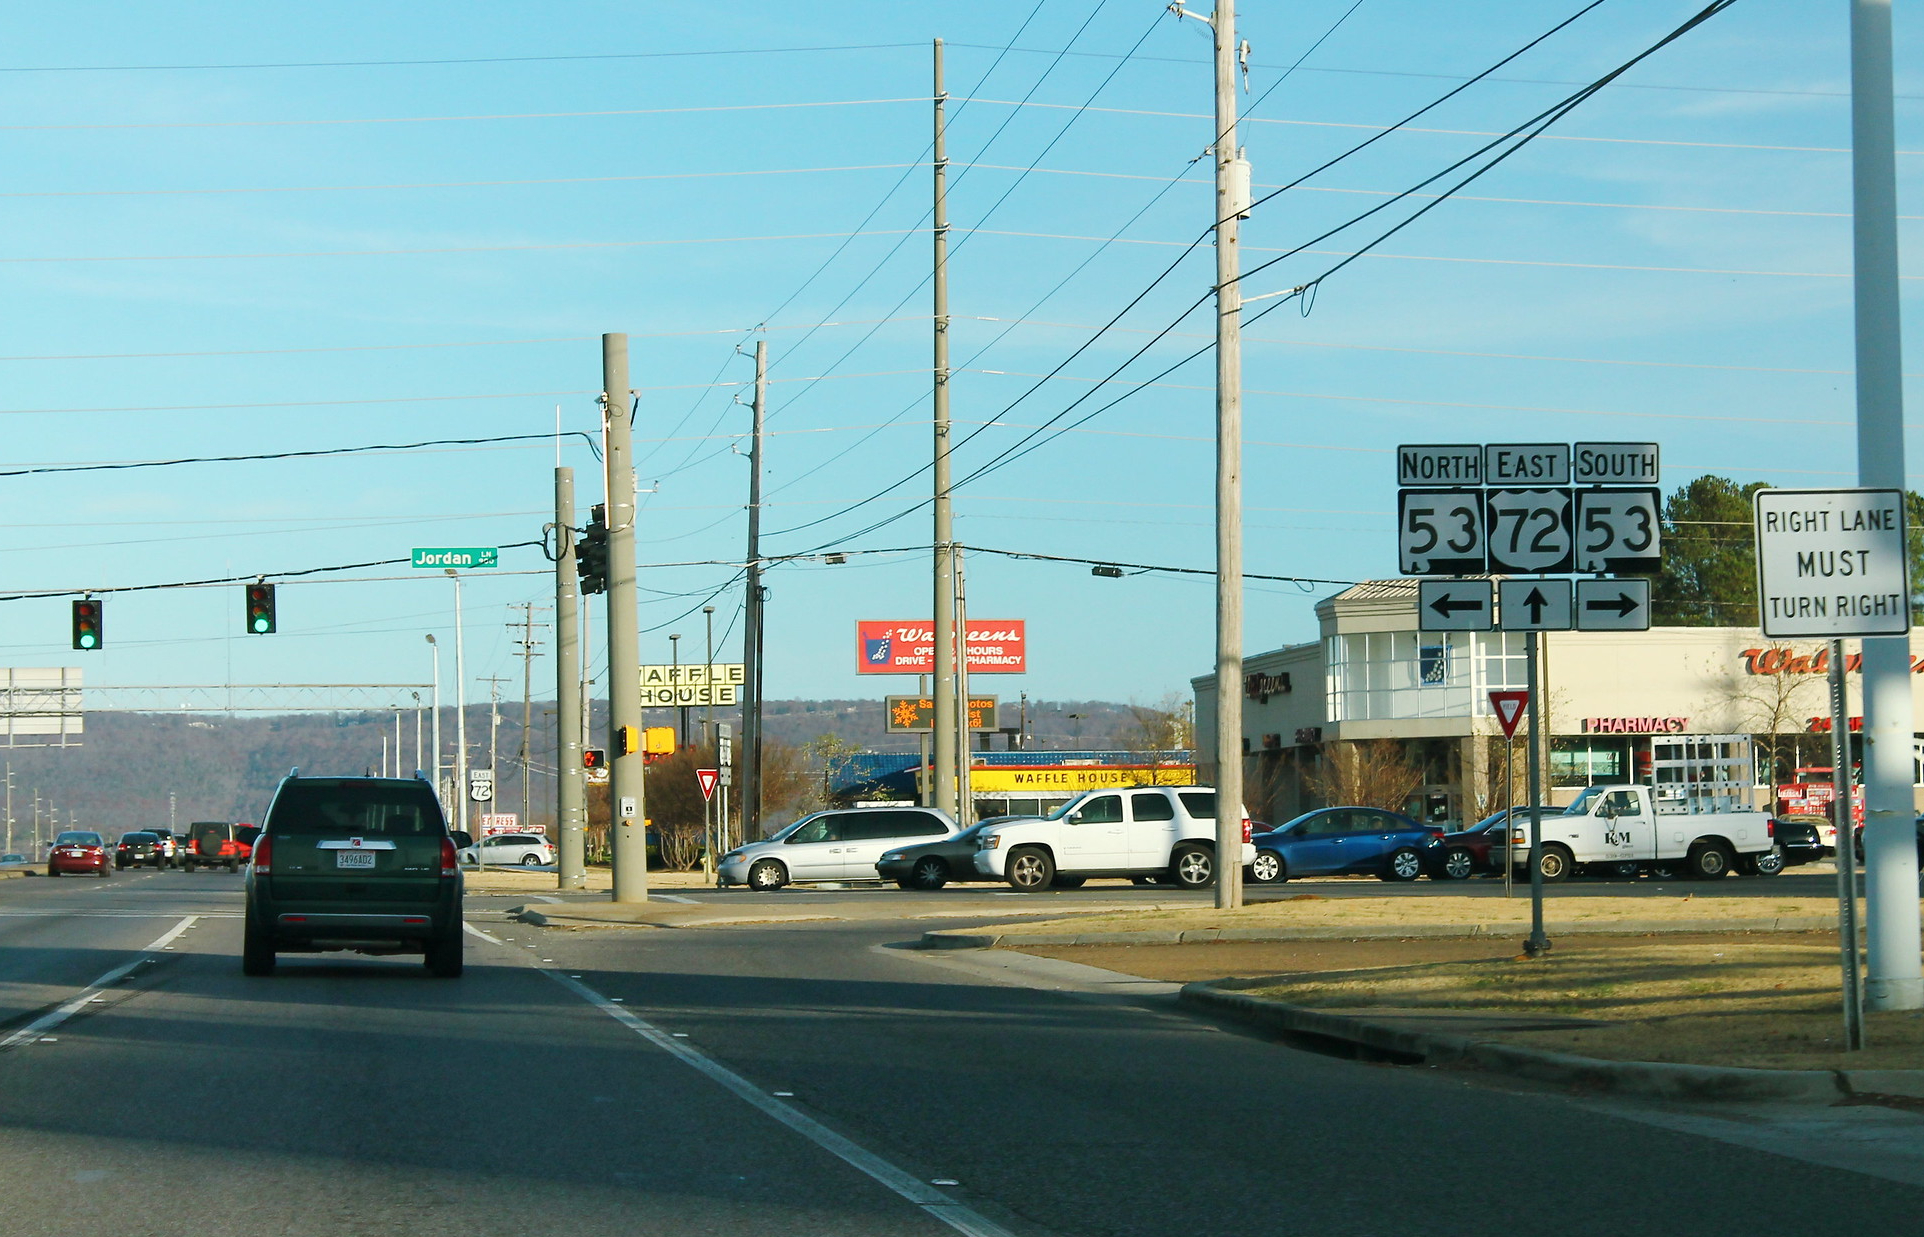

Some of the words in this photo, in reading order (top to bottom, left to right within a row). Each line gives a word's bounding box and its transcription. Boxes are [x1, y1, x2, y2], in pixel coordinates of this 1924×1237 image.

[1402, 452, 1478, 479] NORTH
[1498, 451, 1557, 478] EAST
[1579, 450, 1655, 477] SOUTH
[1409, 506, 1477, 554] 53
[1499, 507, 1560, 553] 72
[1586, 505, 1652, 552] 53
[1766, 510, 1830, 532] RIGHT
[1841, 509, 1895, 531] LANE
[415, 551, 472, 565] Jordan
[1797, 550, 1870, 577] MUST
[1770, 596, 1827, 618] TURN
[1836, 594, 1900, 617] RIGHT
[896, 628, 1021, 642] Waeens
[895, 656, 926, 665] DRIVE
[966, 655, 1022, 665] PHARMACY
[913, 646, 934, 656] OPE
[967, 646, 1004, 655] HOURS
[639, 667, 742, 683] AFFLE
[1584, 717, 1691, 733] PHARMACY
[1014, 773, 1068, 784] WAFFLE
[1078, 772, 1128, 783] HOUSE
[474, 785, 489, 797] 72
